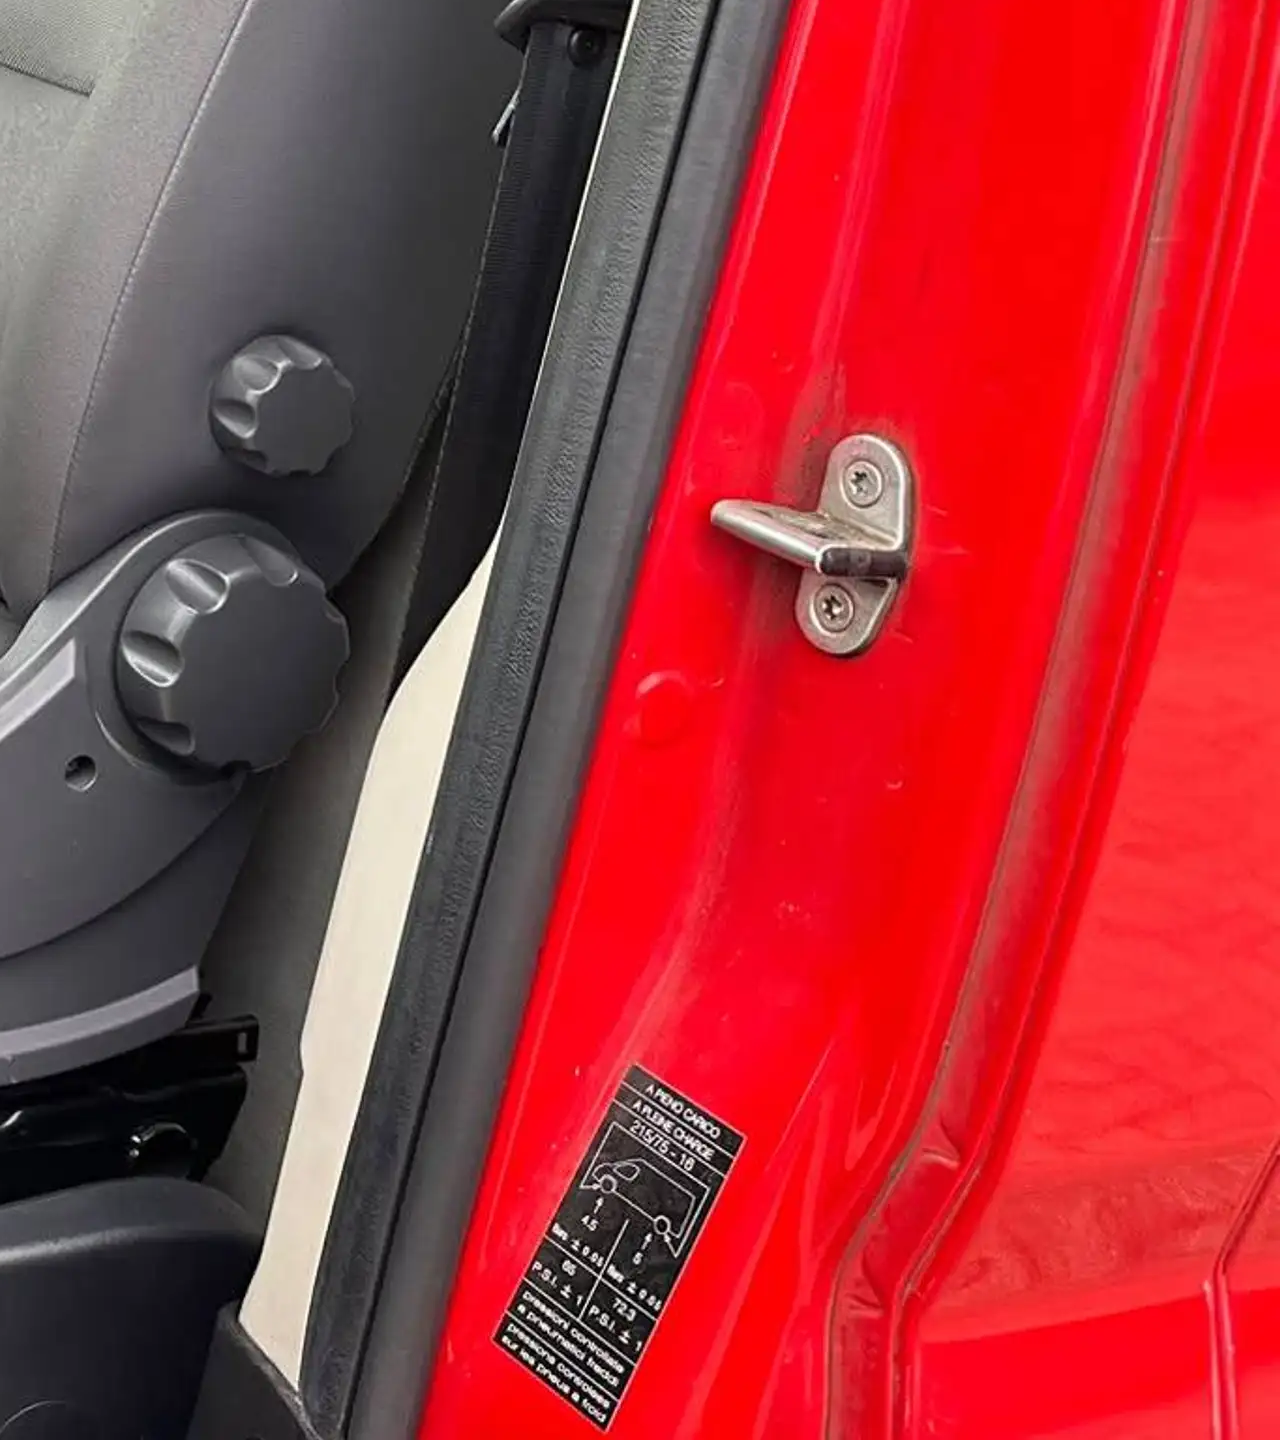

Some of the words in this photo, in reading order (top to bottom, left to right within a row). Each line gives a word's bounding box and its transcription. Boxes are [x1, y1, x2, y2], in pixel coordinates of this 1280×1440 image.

[630, 1119, 671, 1154] 215/75
[632, 1100, 642, 1112] A
[640, 1105, 675, 1134] PLEINE
[672, 1126, 715, 1161] CHARGE
[645, 1083, 655, 1095] A
[653, 1088, 683, 1114] PIENO
[682, 1108, 720, 1139] CARICO
